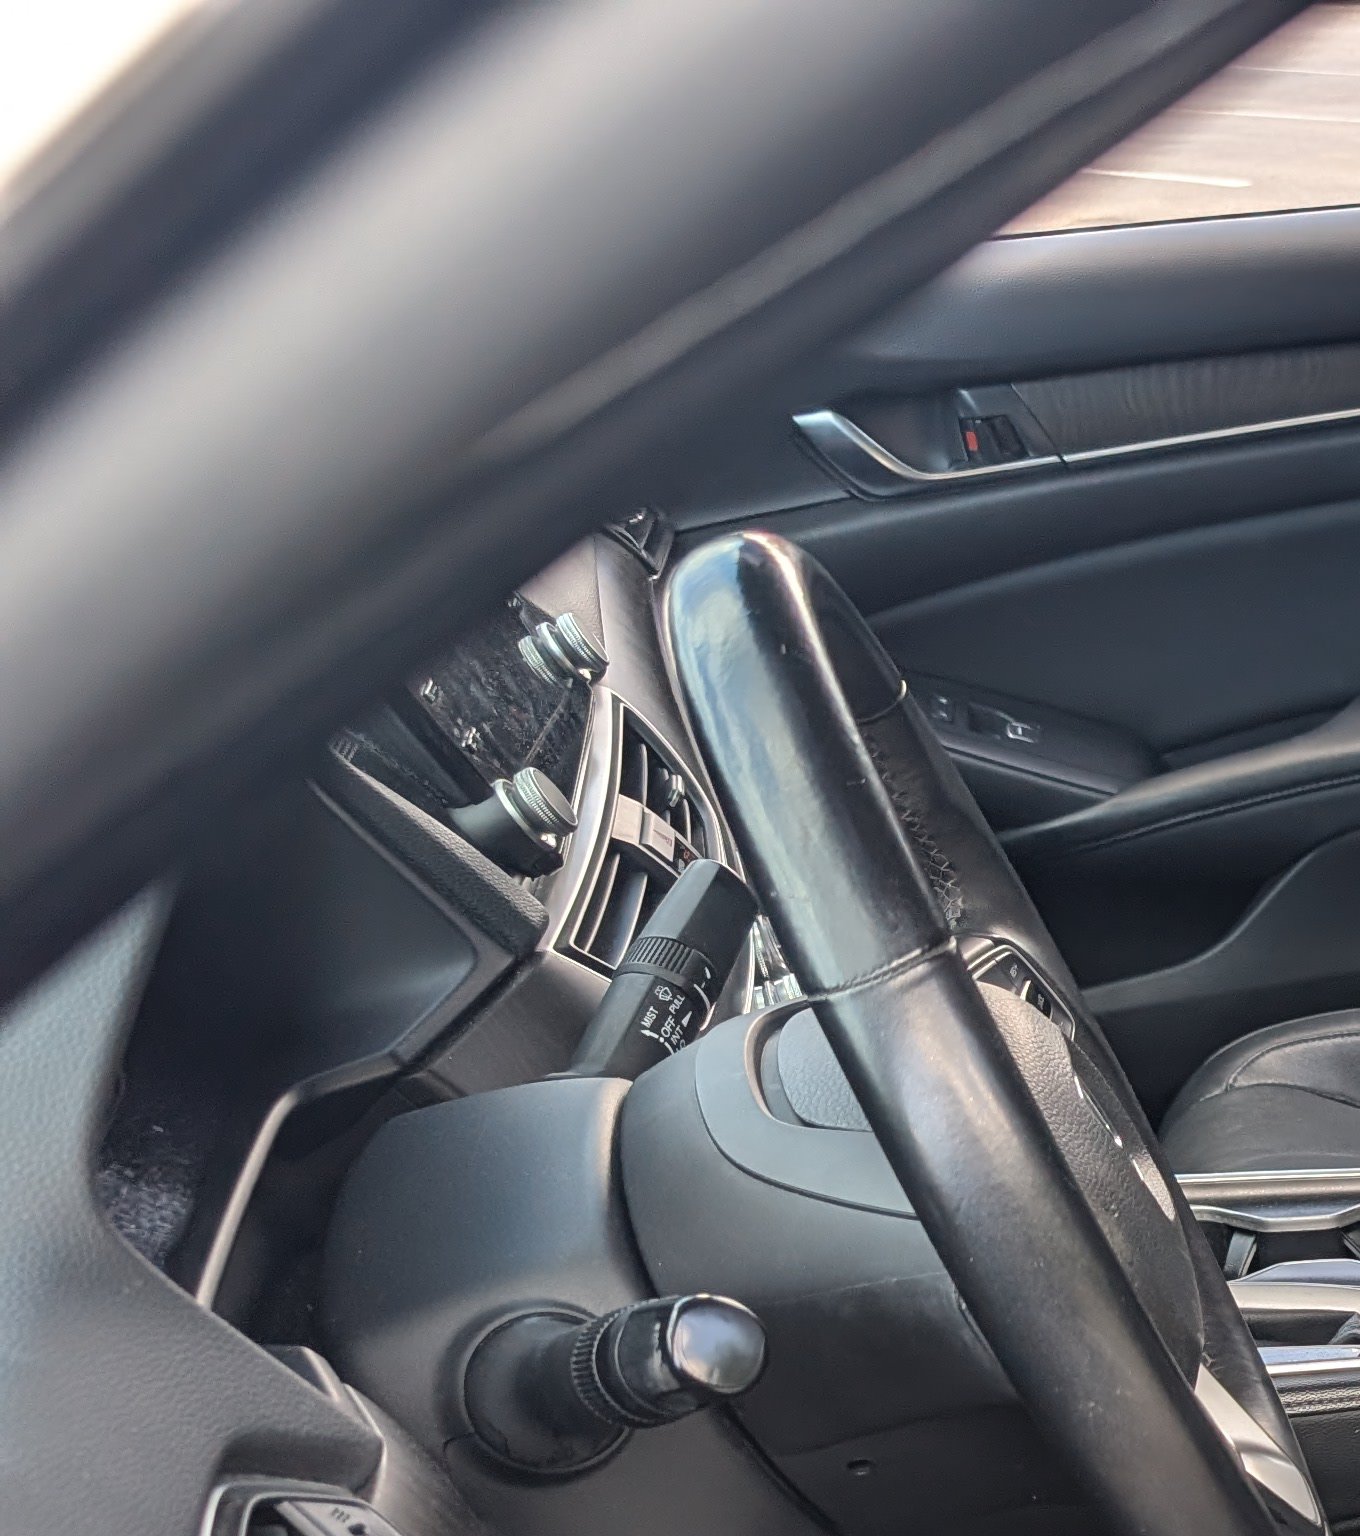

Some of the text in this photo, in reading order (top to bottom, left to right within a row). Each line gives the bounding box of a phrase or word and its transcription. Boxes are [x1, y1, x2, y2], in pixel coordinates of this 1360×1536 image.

[669, 995, 686, 1015] PULL
[641, 1005, 659, 1029] MIST
[661, 1015, 677, 1038] OFF
[670, 1025, 684, 1045] INT
